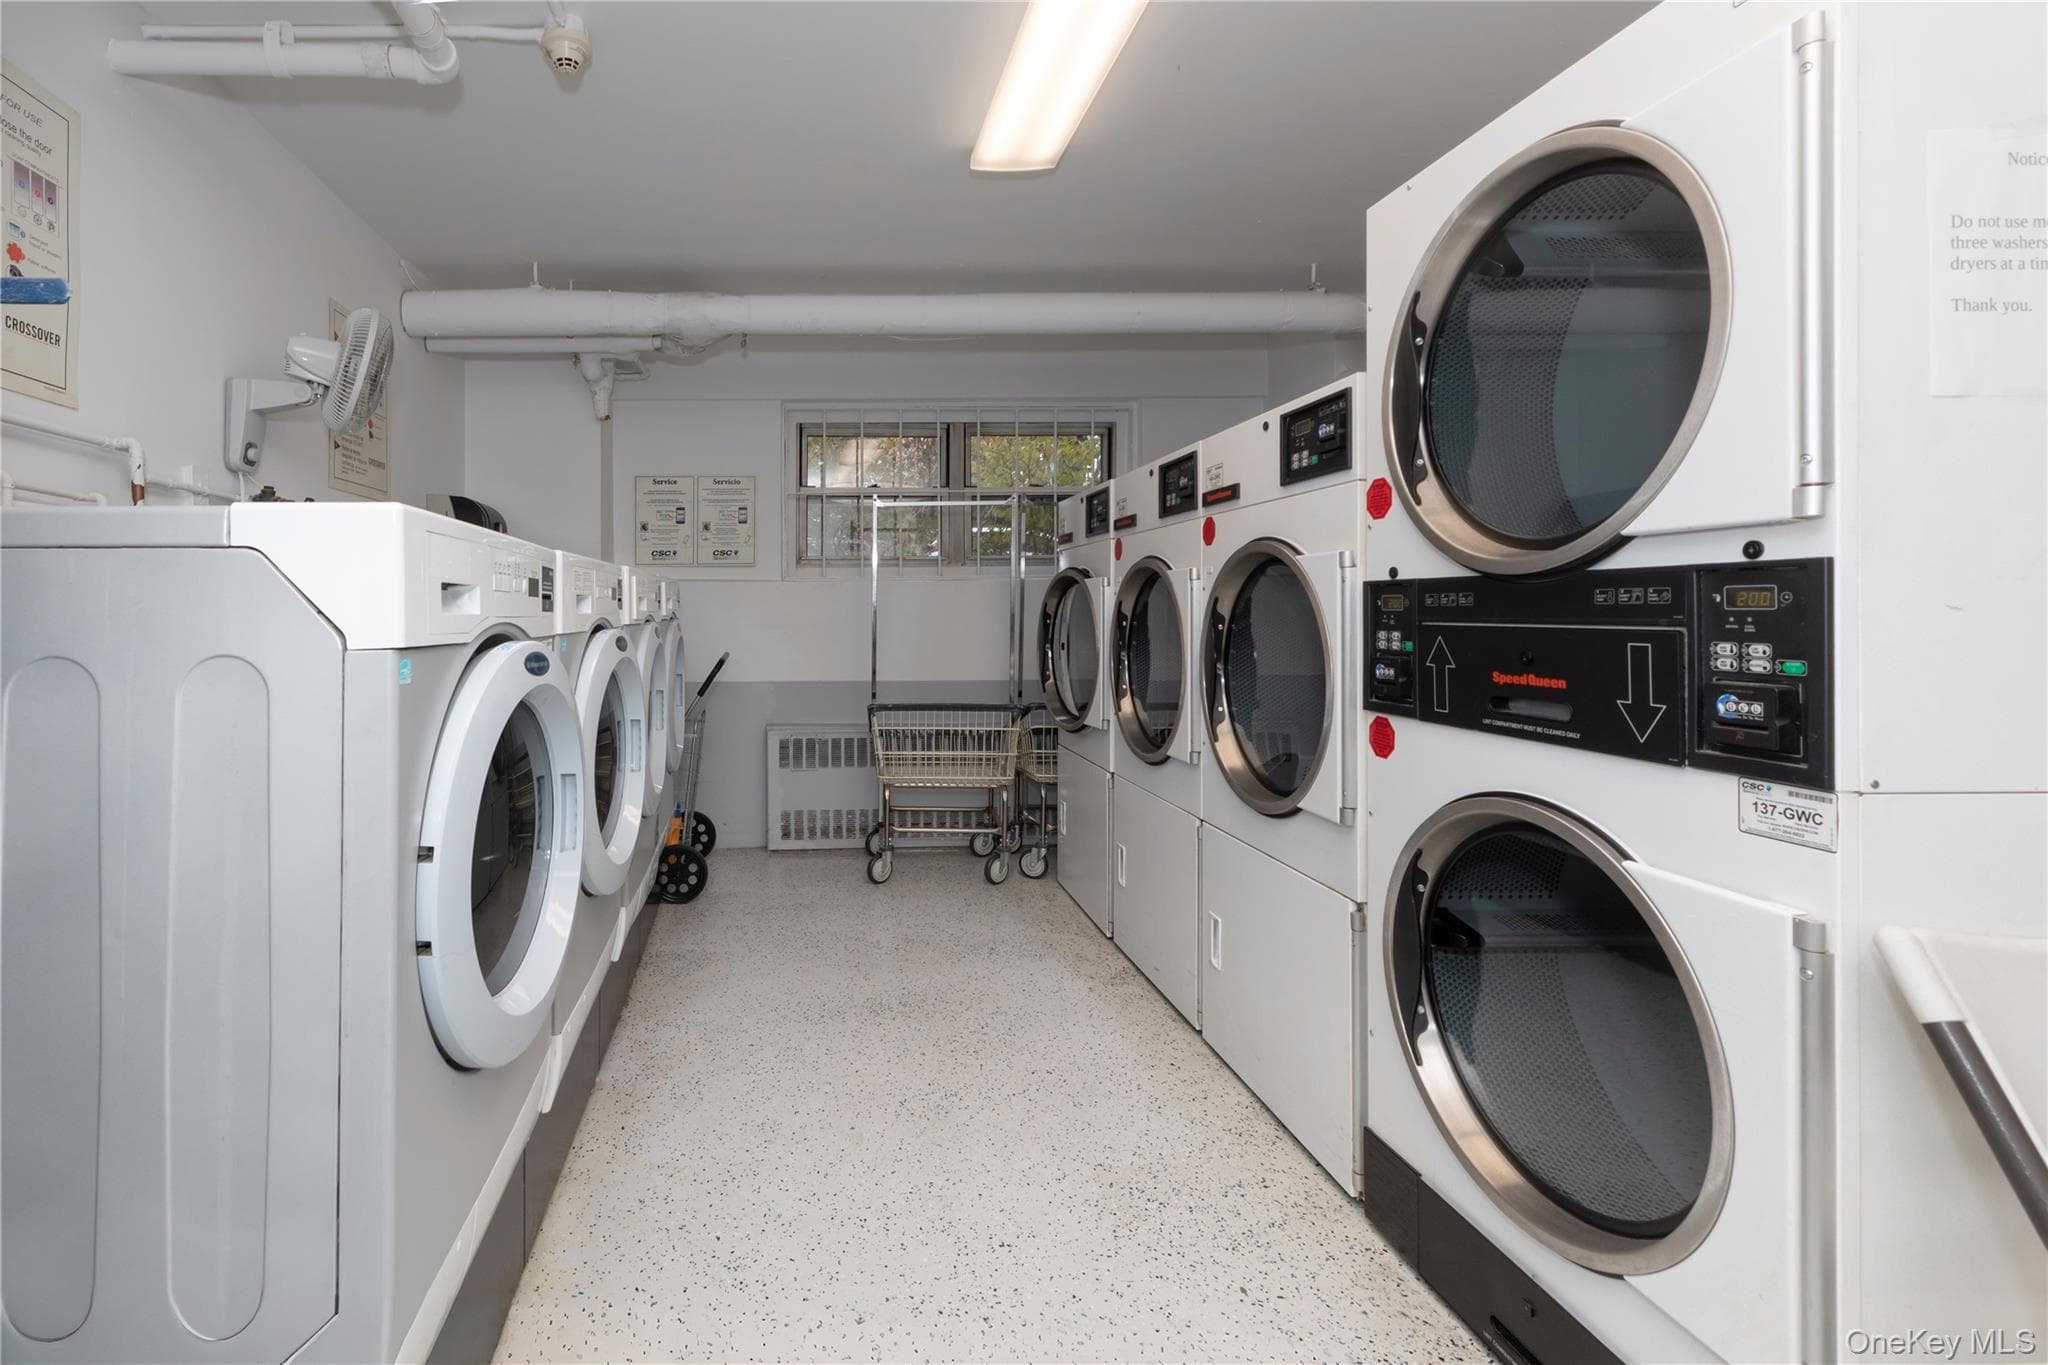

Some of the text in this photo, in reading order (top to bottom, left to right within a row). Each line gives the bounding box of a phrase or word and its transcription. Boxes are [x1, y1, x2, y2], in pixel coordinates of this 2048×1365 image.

[23, 109, 43, 127] USE
[0, 117, 53, 155] ose the door
[1950, 214, 1973, 229] Do
[1977, 215, 2001, 229] not
[2004, 217, 2029, 229] use
[1950, 235, 2048, 249] three washers
[1950, 256, 1997, 273] dryers
[2000, 258, 2013, 271] at
[2017, 260, 2026, 271] a
[1951, 298, 2033, 316] Thank you.
[5, 315, 61, 347] CROSSOVER
[1736, 591, 1771, 607] 200
[1492, 720, 1522, 729] COMPARTMENT
[1543, 728, 1566, 736] CLEANED
[1742, 781, 1764, 791] CSC
[1752, 801, 1824, 826] 137-GWC
